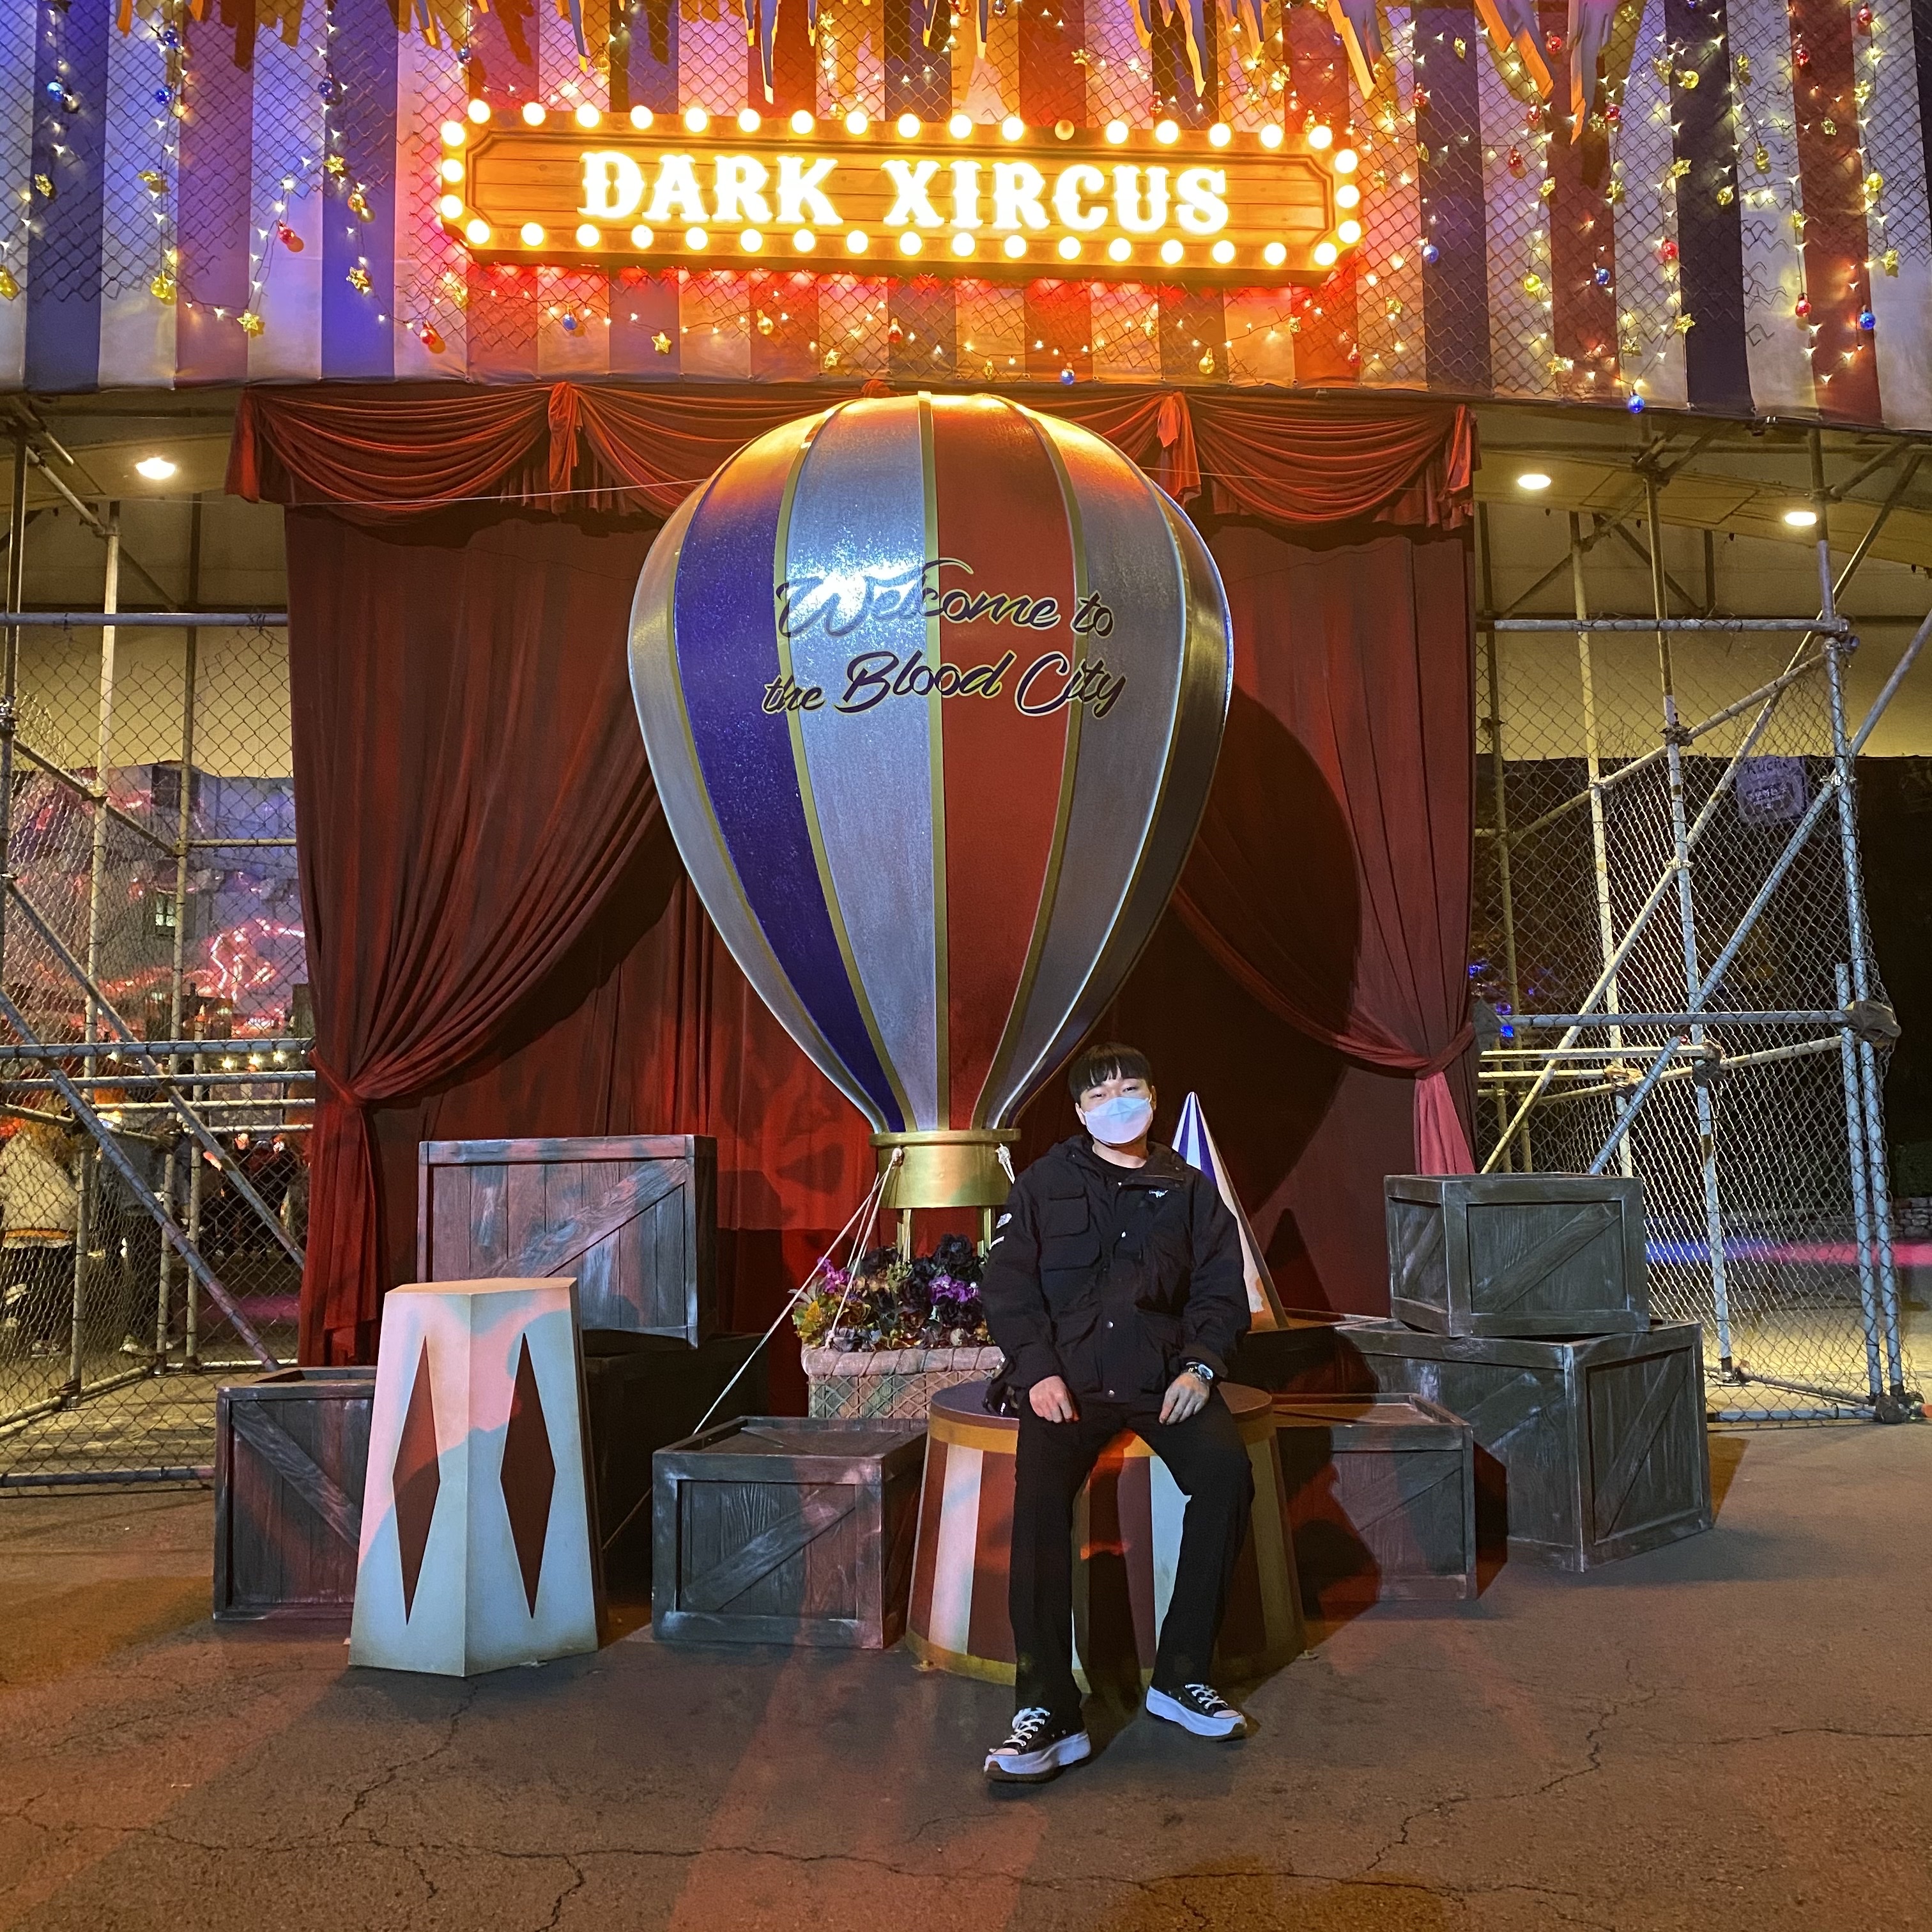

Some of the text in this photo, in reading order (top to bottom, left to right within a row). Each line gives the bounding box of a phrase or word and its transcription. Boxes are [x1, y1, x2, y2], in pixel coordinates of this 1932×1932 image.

[577, 151, 1229, 234] DARK XIRCUS
[776, 557, 1114, 638] Welcome to
[762, 648, 1128, 720] the Blood City
